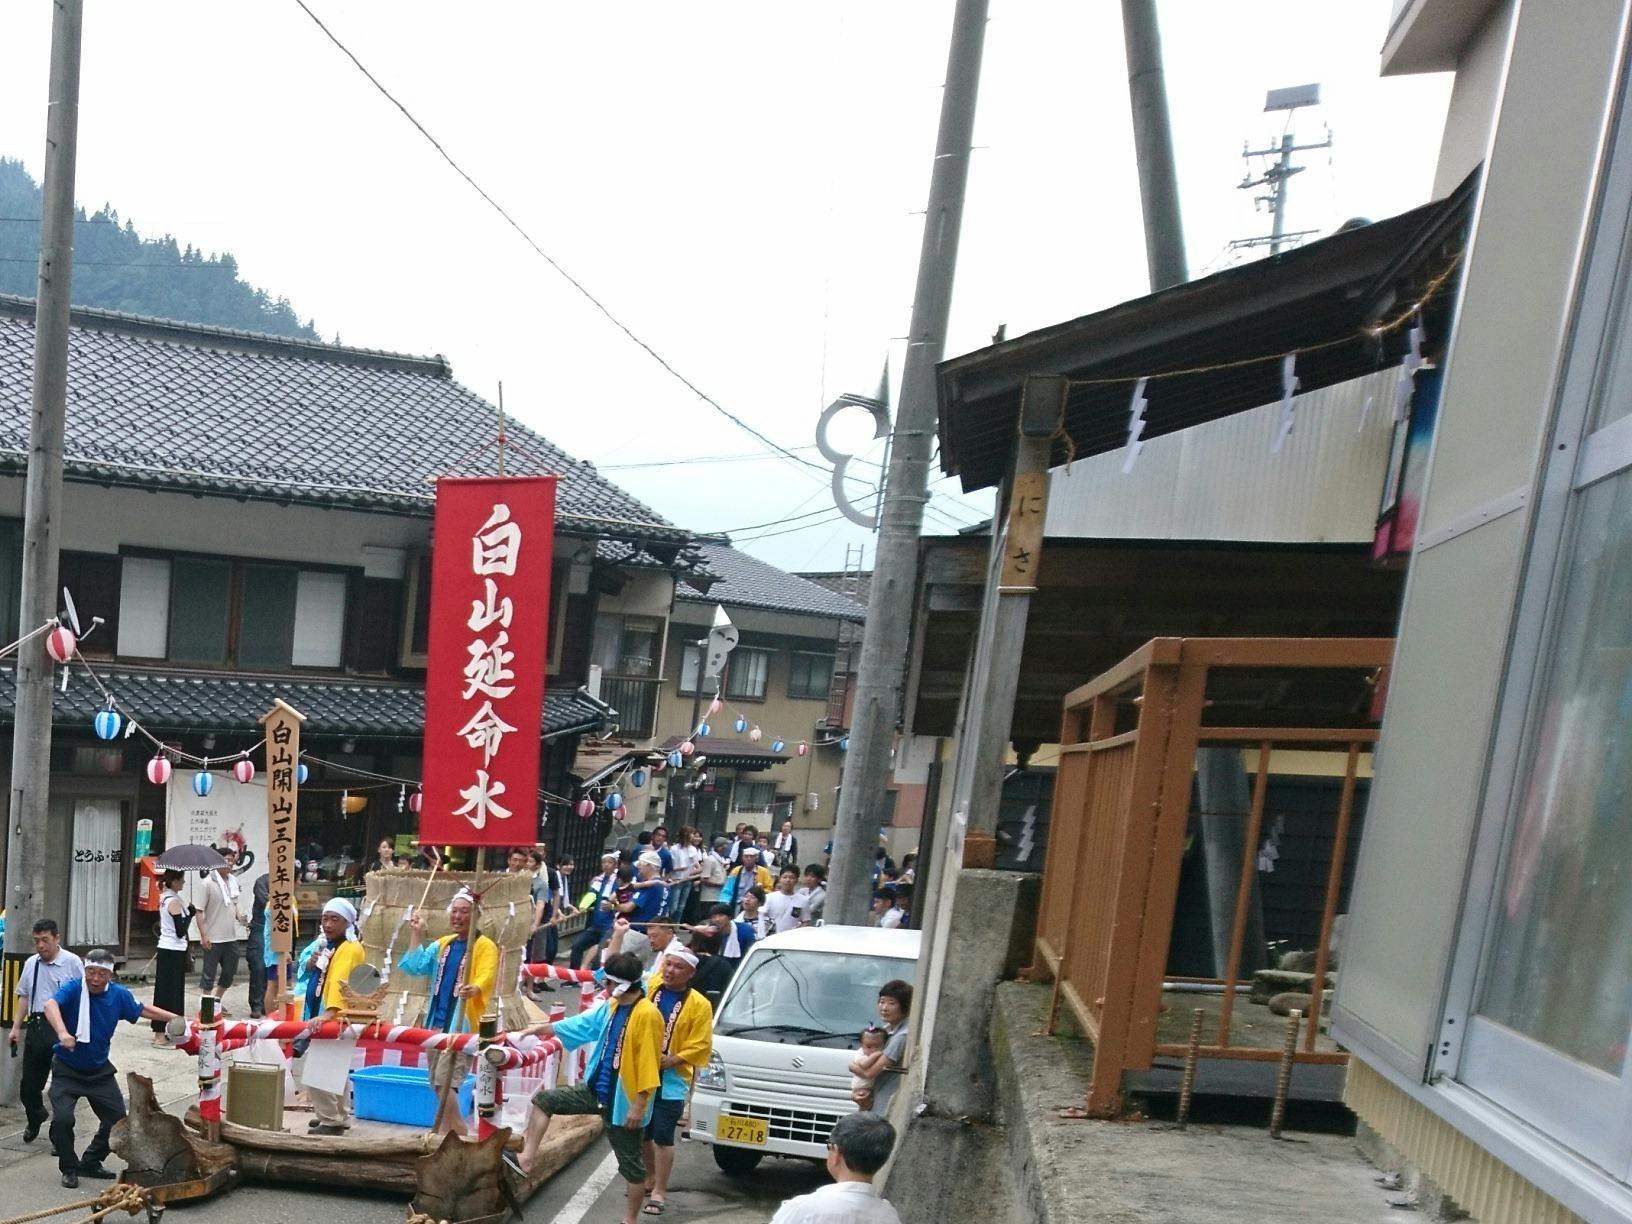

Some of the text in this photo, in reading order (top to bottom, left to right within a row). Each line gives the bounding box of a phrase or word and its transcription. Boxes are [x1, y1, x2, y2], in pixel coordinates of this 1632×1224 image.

[451, 503, 522, 829] 白山延命水
[727, 1126, 764, 1143] 27-18
